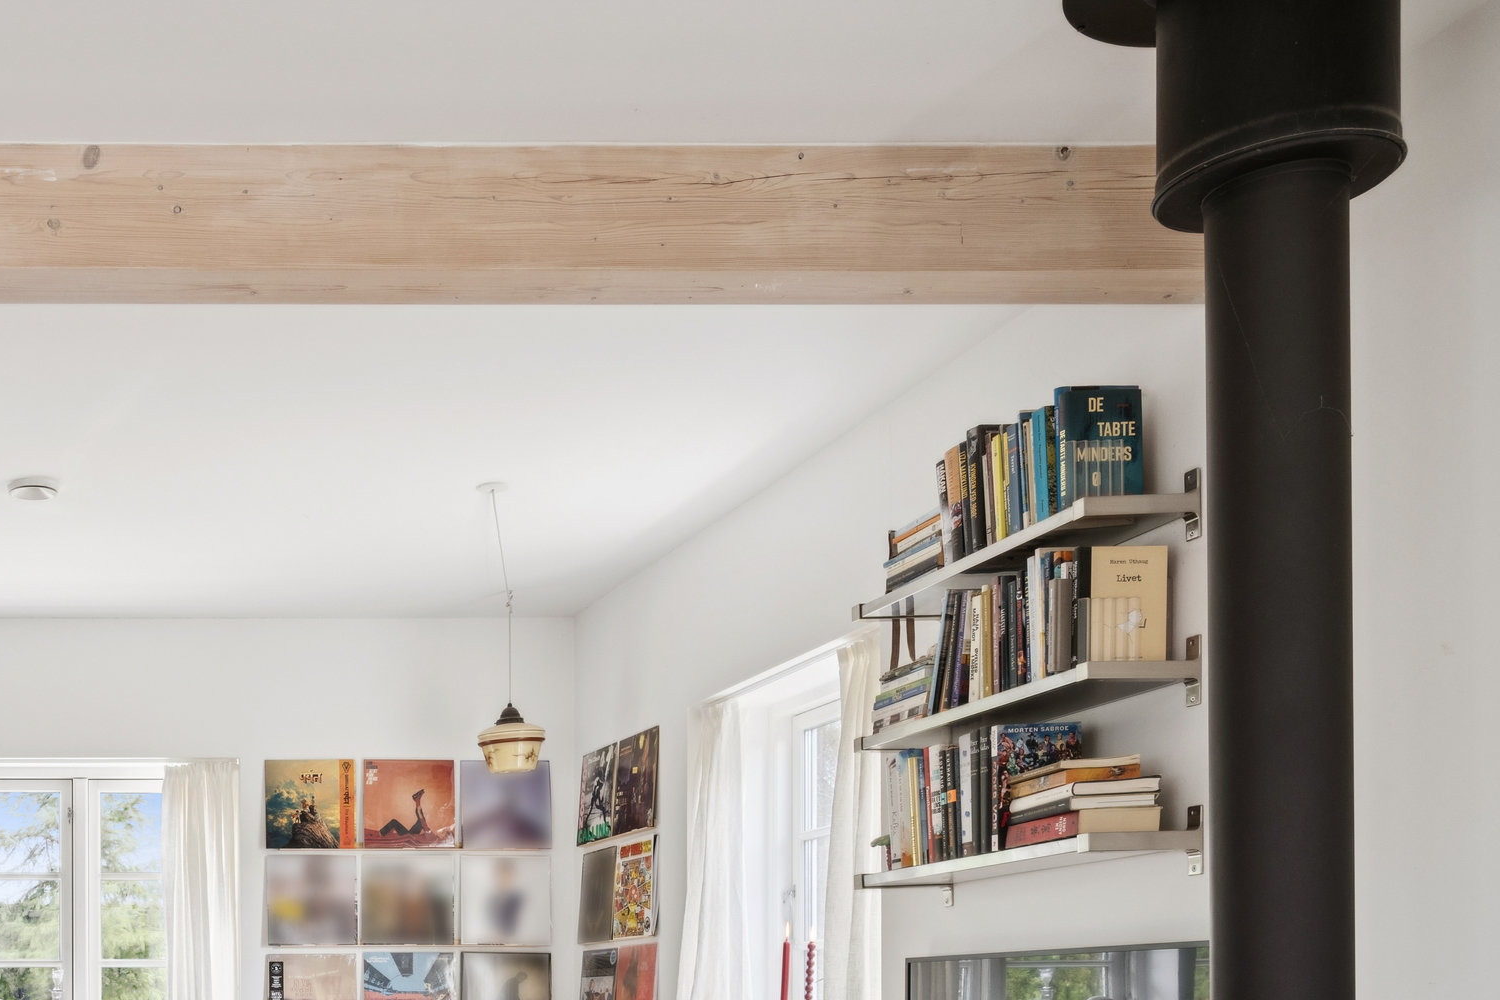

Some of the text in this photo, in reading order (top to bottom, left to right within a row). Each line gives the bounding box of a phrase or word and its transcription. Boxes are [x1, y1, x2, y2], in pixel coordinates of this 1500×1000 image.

[1088, 397, 1104, 413] DE
[1060, 429, 1066, 440] DE
[1097, 421, 1136, 437] TABTE
[1077, 446, 1132, 462] MINDERS
[1117, 574, 1142, 583] Livet
[578, 821, 611, 843] CALLING
